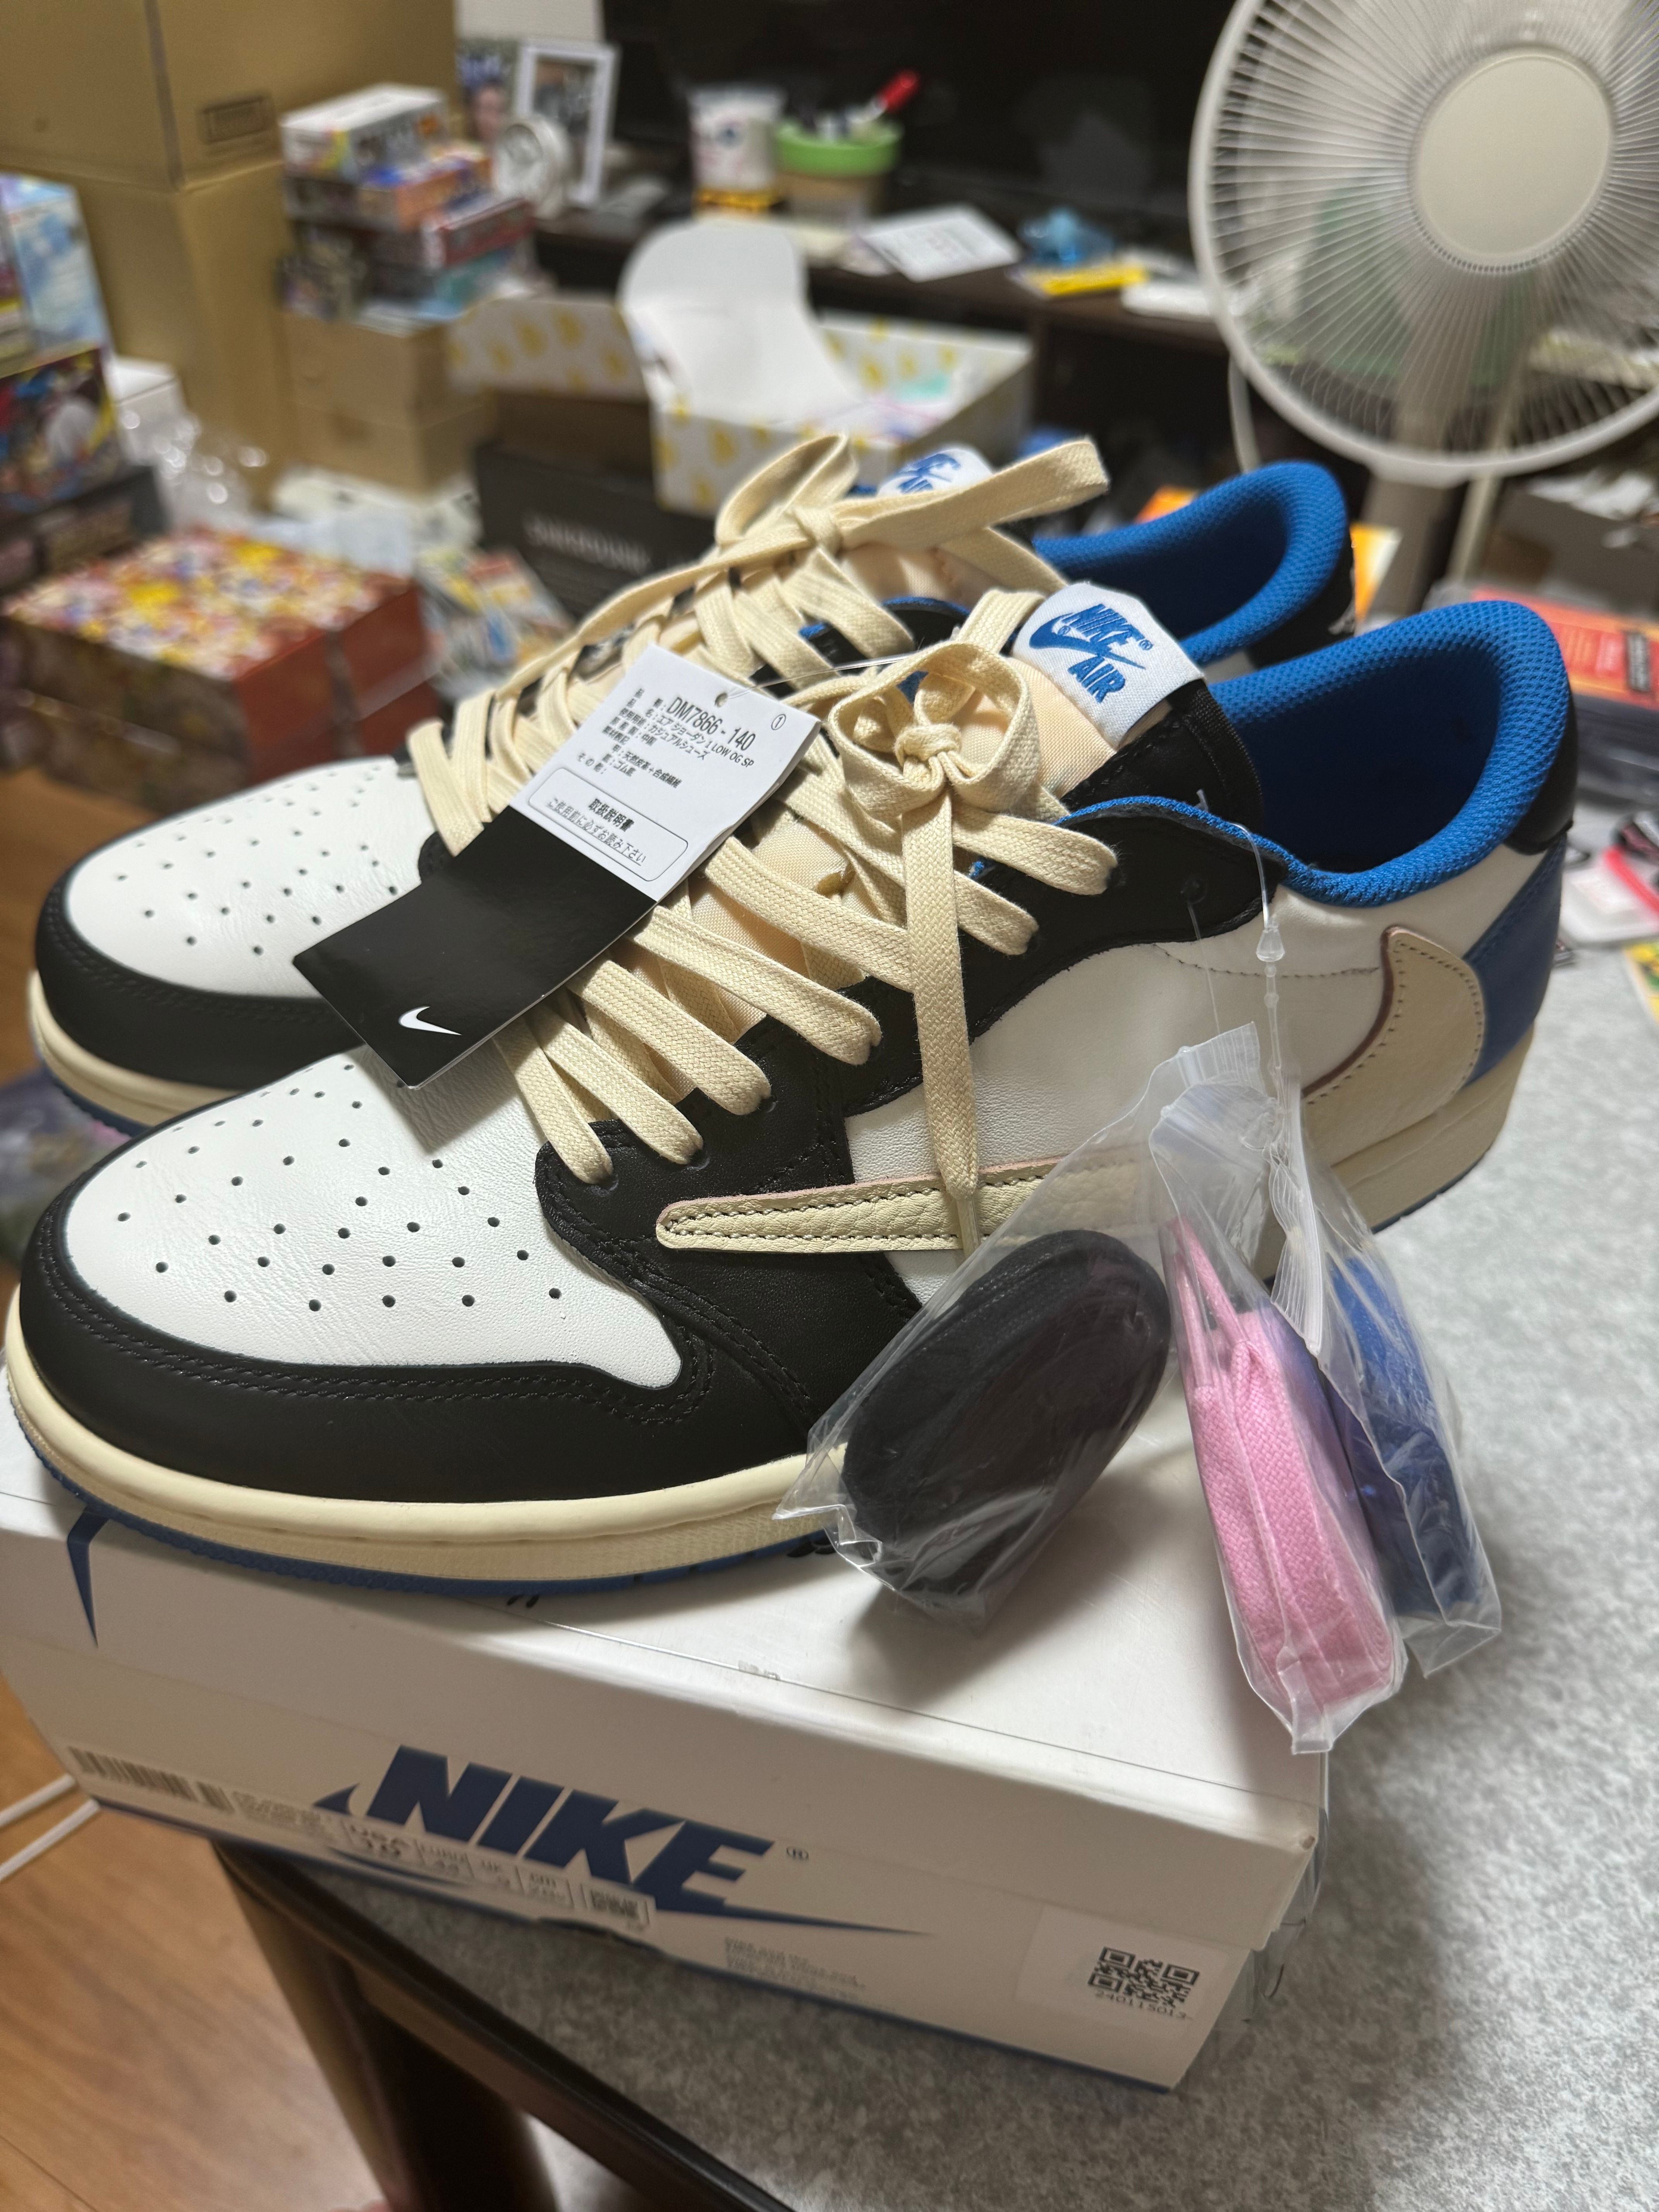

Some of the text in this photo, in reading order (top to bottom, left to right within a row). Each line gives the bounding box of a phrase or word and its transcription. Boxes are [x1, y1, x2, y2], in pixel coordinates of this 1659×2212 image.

[1060, 603, 1146, 652] NIKE
[1067, 657, 1126, 703] AIR
[666, 696, 723, 735] DM7866
[727, 727, 756, 751] 140
[711, 743, 731, 757] LOW
[730, 752, 744, 763] OG
[741, 757, 754, 768] SP
[587, 798, 635, 832] 取扱説明書
[365, 1744, 775, 1910] NIKE
